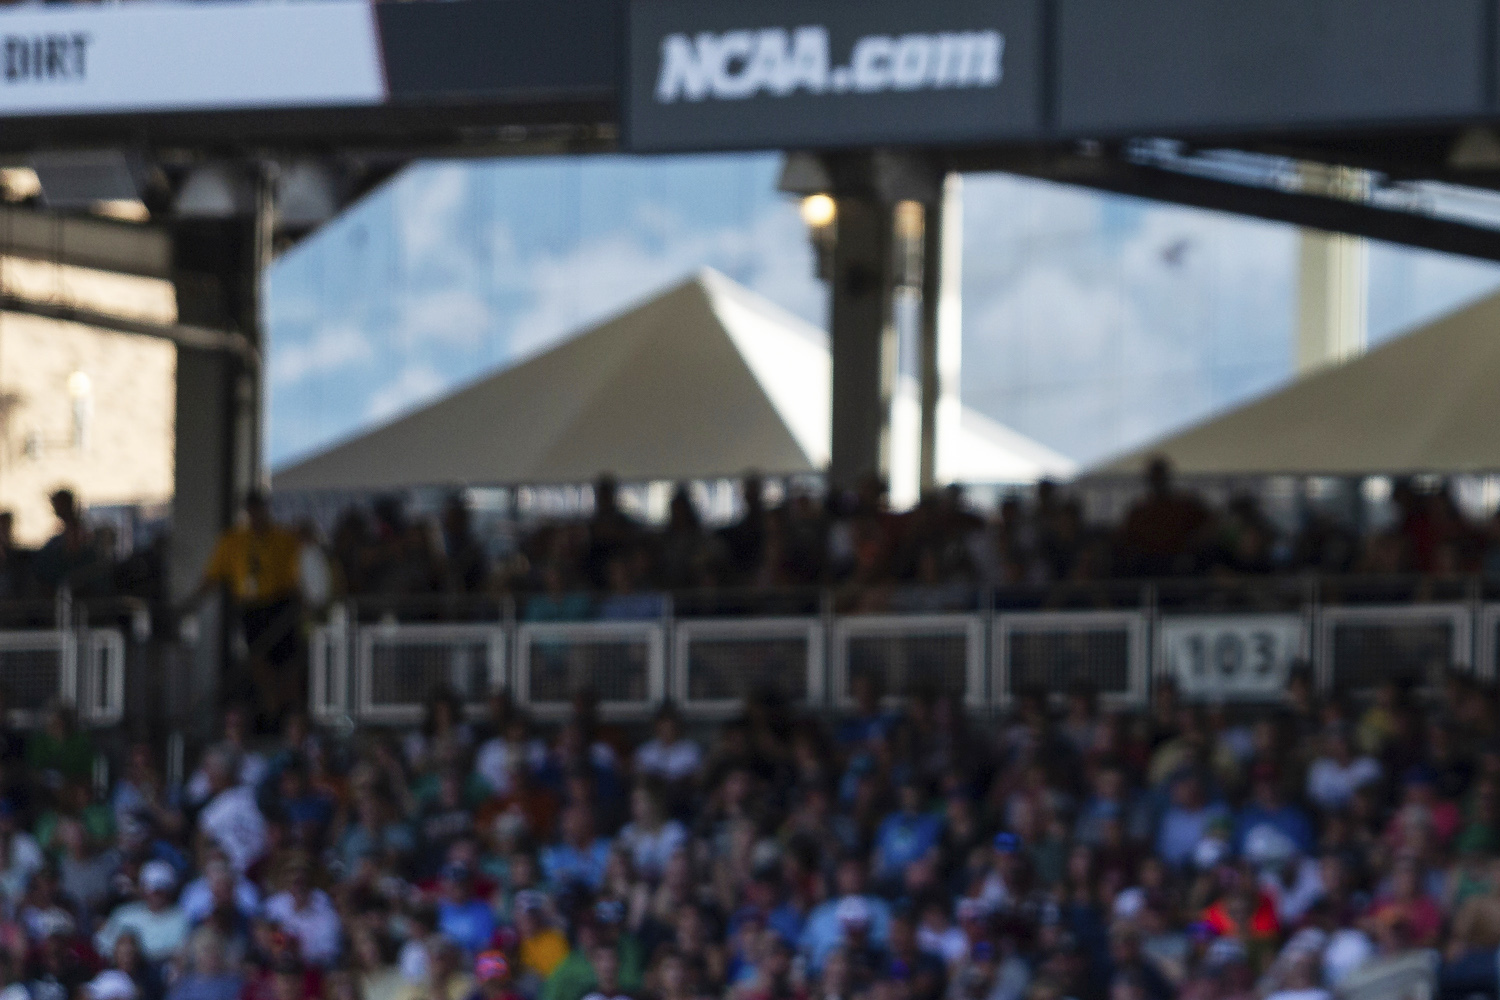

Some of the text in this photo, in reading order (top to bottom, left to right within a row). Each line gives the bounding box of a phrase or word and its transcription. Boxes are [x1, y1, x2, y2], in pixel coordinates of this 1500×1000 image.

[5, 31, 91, 84] DIRT
[656, 26, 1004, 101] NCAA.com
[1185, 631, 1277, 678] 103
